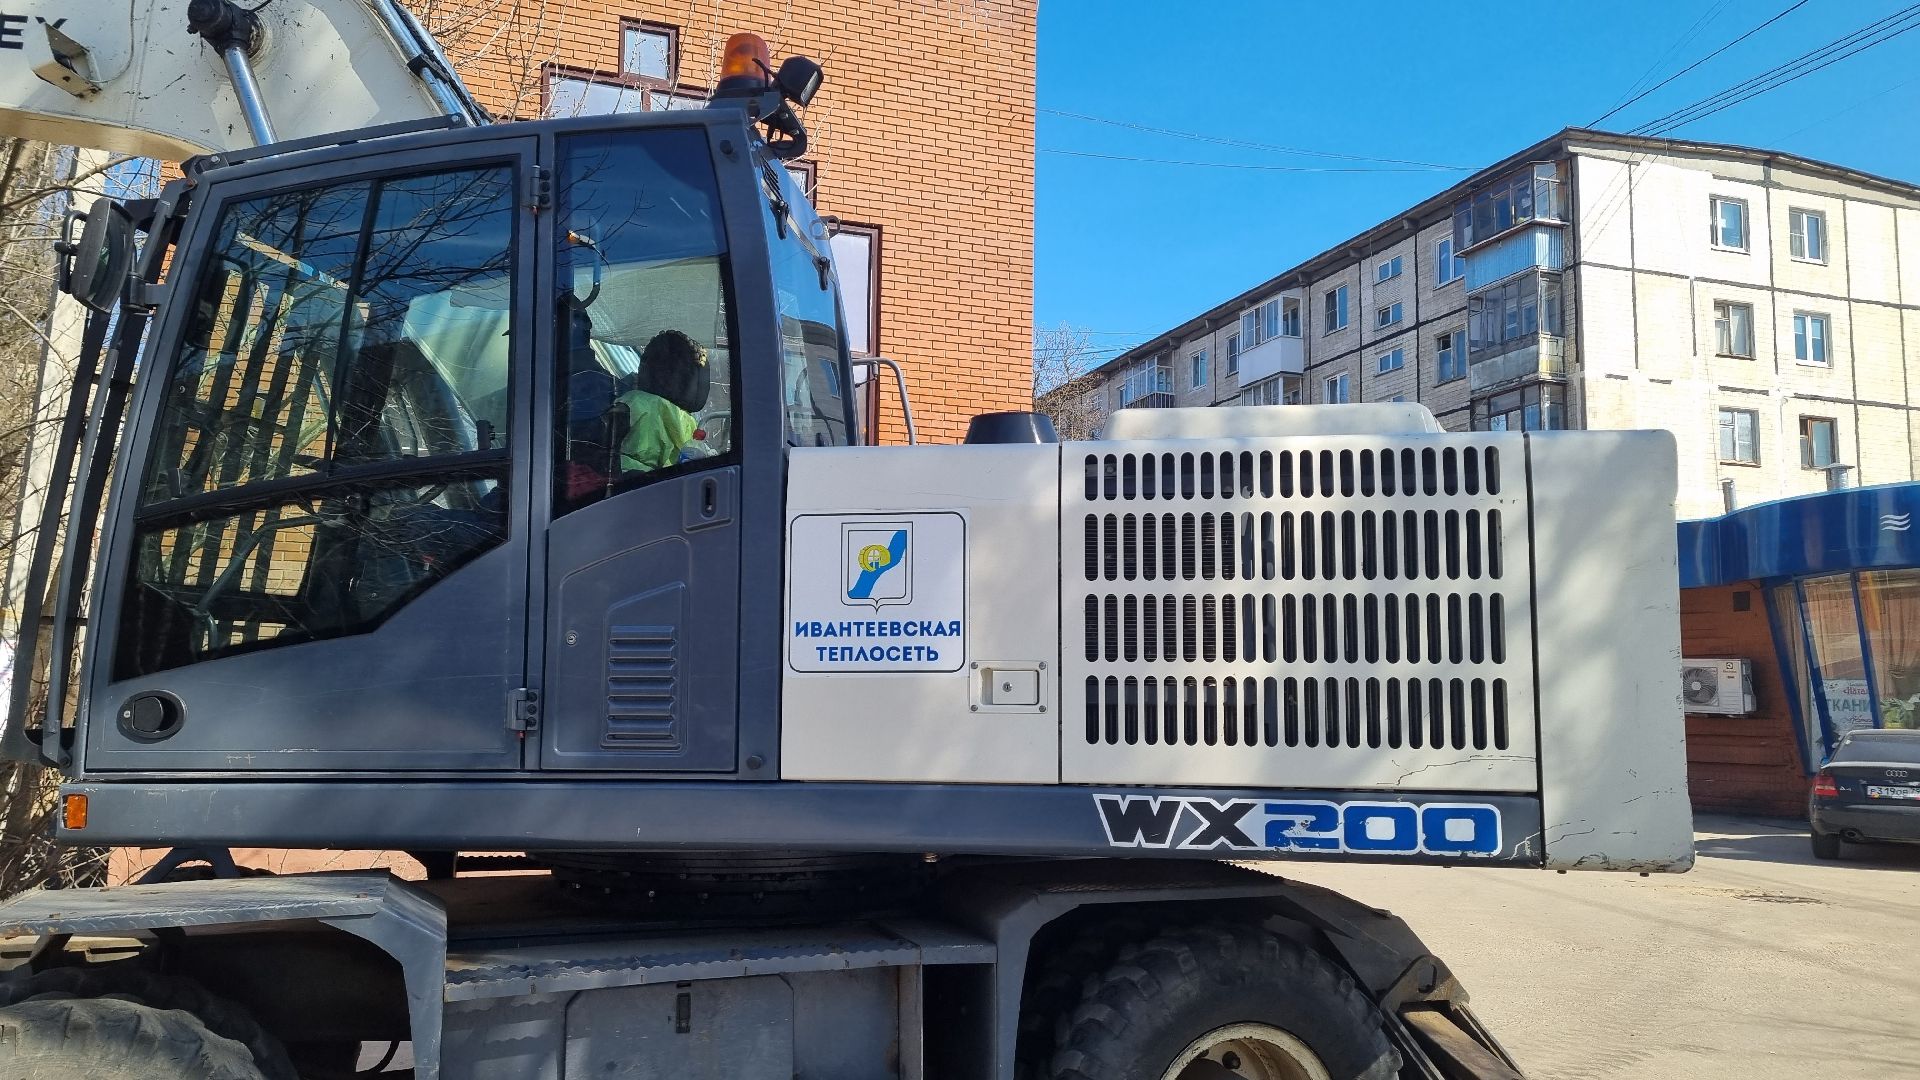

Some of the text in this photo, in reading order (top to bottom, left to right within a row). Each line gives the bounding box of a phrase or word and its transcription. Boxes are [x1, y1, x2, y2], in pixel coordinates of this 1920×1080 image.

[795, 620, 961, 638] ИВАНТЕЕВСКАЯ
[815, 645, 939, 662] ТЕПЛОСЕТЬ
[1095, 795, 1501, 855] WX200
